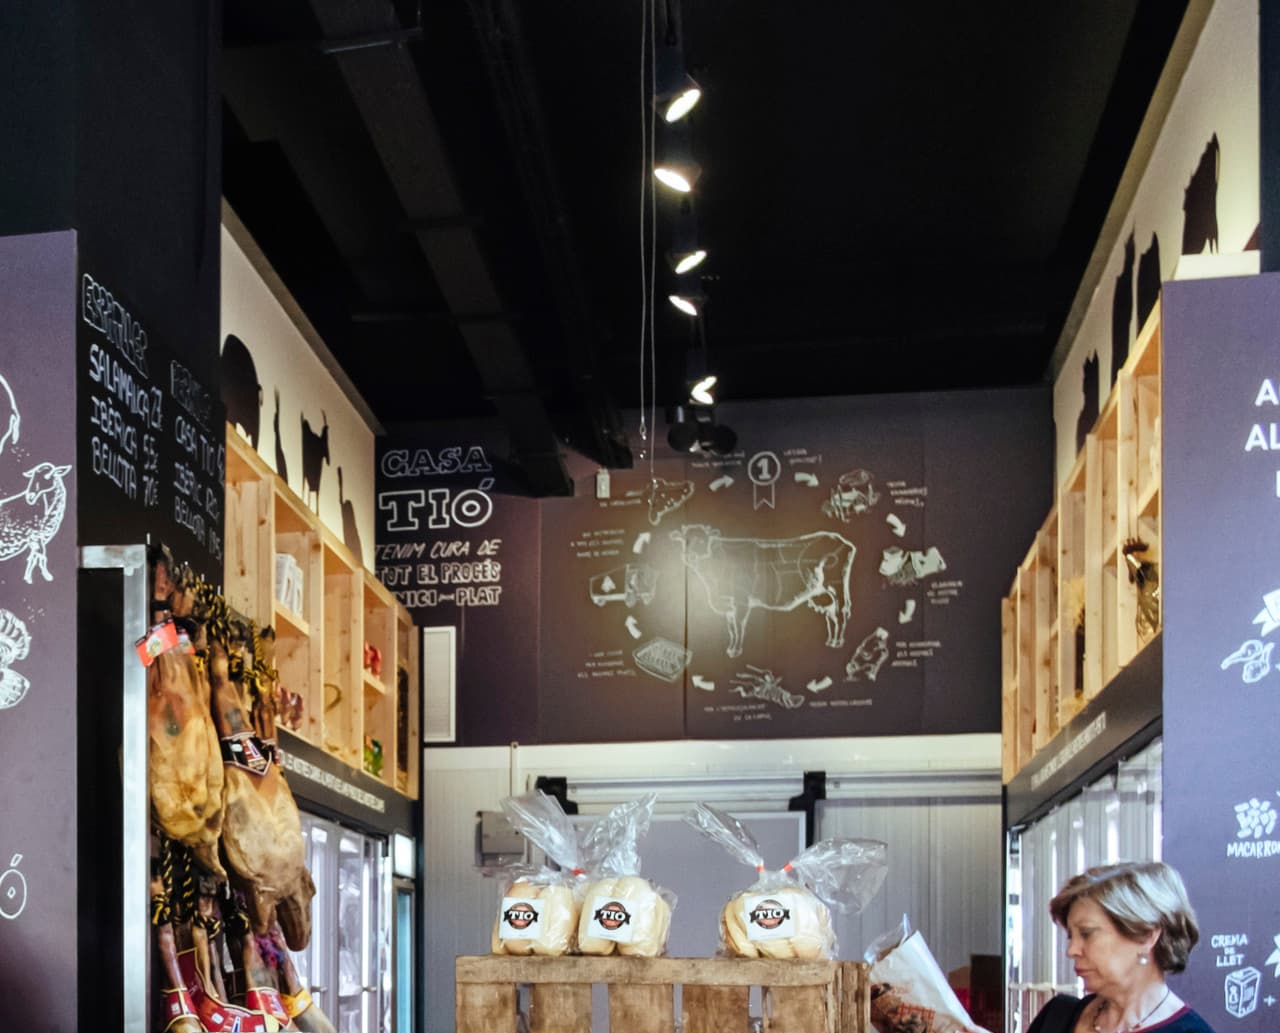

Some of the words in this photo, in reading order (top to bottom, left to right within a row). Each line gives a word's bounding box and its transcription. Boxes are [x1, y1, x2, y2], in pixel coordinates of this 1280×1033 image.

[1255, 378, 1280, 407] A
[381, 446, 492, 477] CASA
[379, 478, 495, 531] TIÓ
[430, 541, 470, 559] CURA
[477, 539, 502, 556] DE
[417, 563, 439, 584] EL
[456, 586, 502, 607] PLAT
[1211, 934, 1248, 948] CREMA
[1216, 954, 1245, 967] LLET
